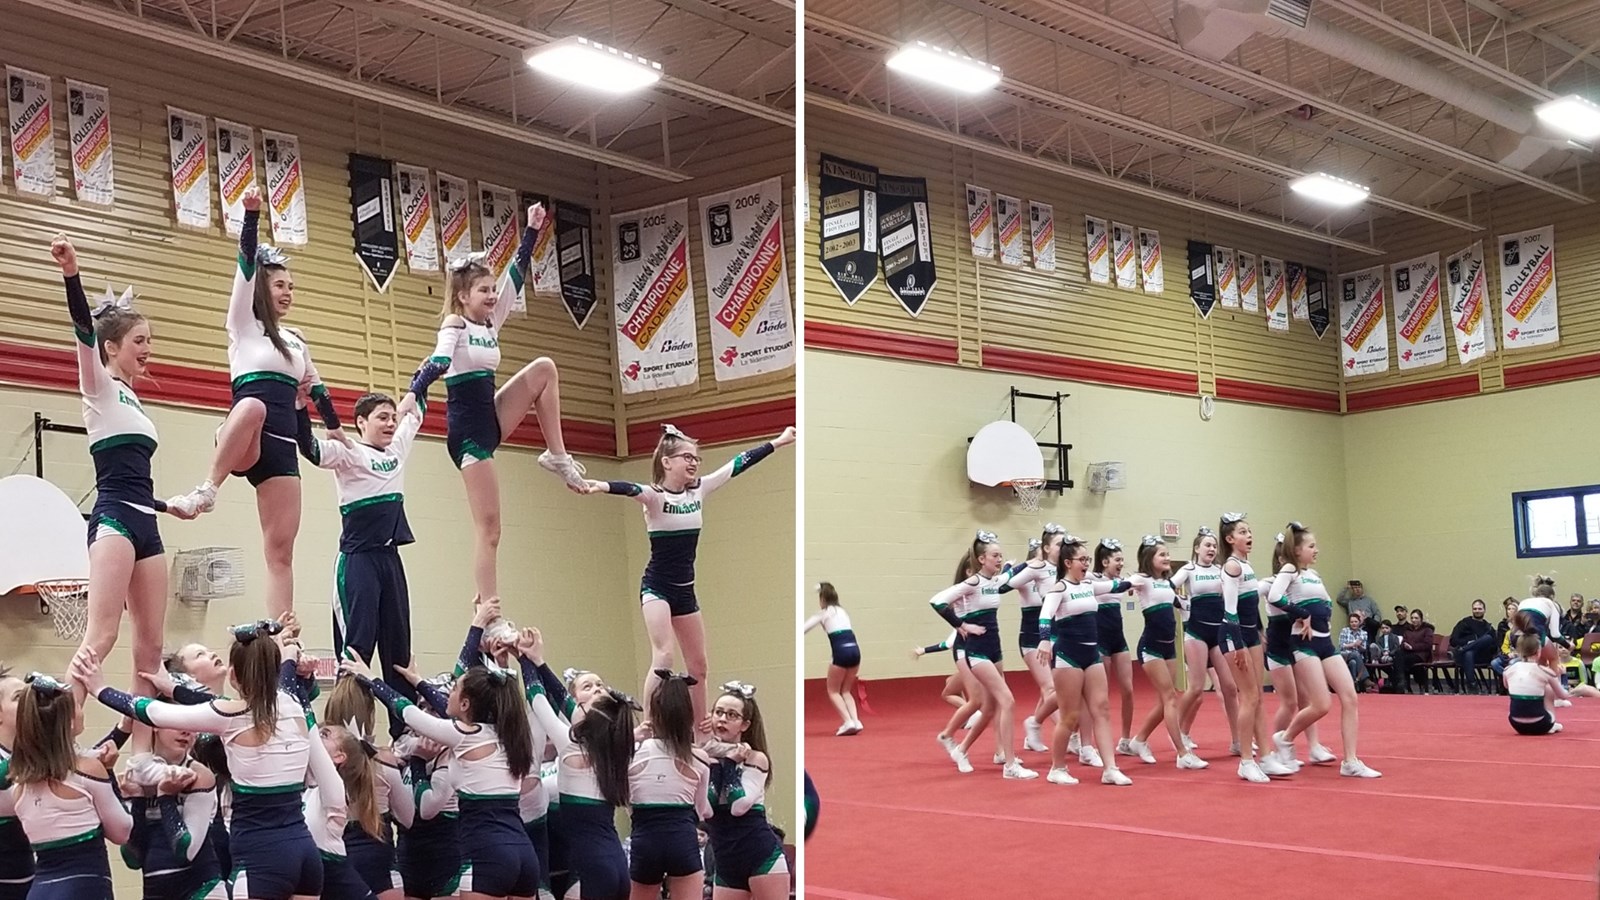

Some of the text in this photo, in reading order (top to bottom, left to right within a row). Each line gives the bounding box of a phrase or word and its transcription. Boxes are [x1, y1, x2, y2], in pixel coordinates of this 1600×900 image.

[12, 94, 48, 135] BASKETBALL
[72, 106, 105, 145] VOLLEYBALL
[76, 123, 107, 164] CHAMPIONS
[172, 132, 203, 171] BASKETBALL
[175, 150, 204, 187] CHAMPIONS
[223, 162, 251, 197] CHAMPIONS
[403, 182, 427, 221] HOCKEY
[735, 193, 760, 210] 2006
[969, 199, 988, 223] HOCKEY
[642, 214, 668, 229] 2005
[1524, 234, 1541, 244] 2007
[722, 238, 779, 323] CHAMPIONNE
[1504, 244, 1549, 297] VOLLEYBALL
[1510, 263, 1551, 313] CHAMPIONNES
[627, 257, 684, 336] CHAMPIONNE
[640, 278, 686, 345] CADETTE
[737, 260, 781, 332] JUVENILE
[1403, 287, 1437, 336] CHAMPIONNE
[1348, 298, 1381, 344] CHAMPIONNE
[643, 364, 664, 373] SPORT
[740, 348, 762, 359] SPORT
